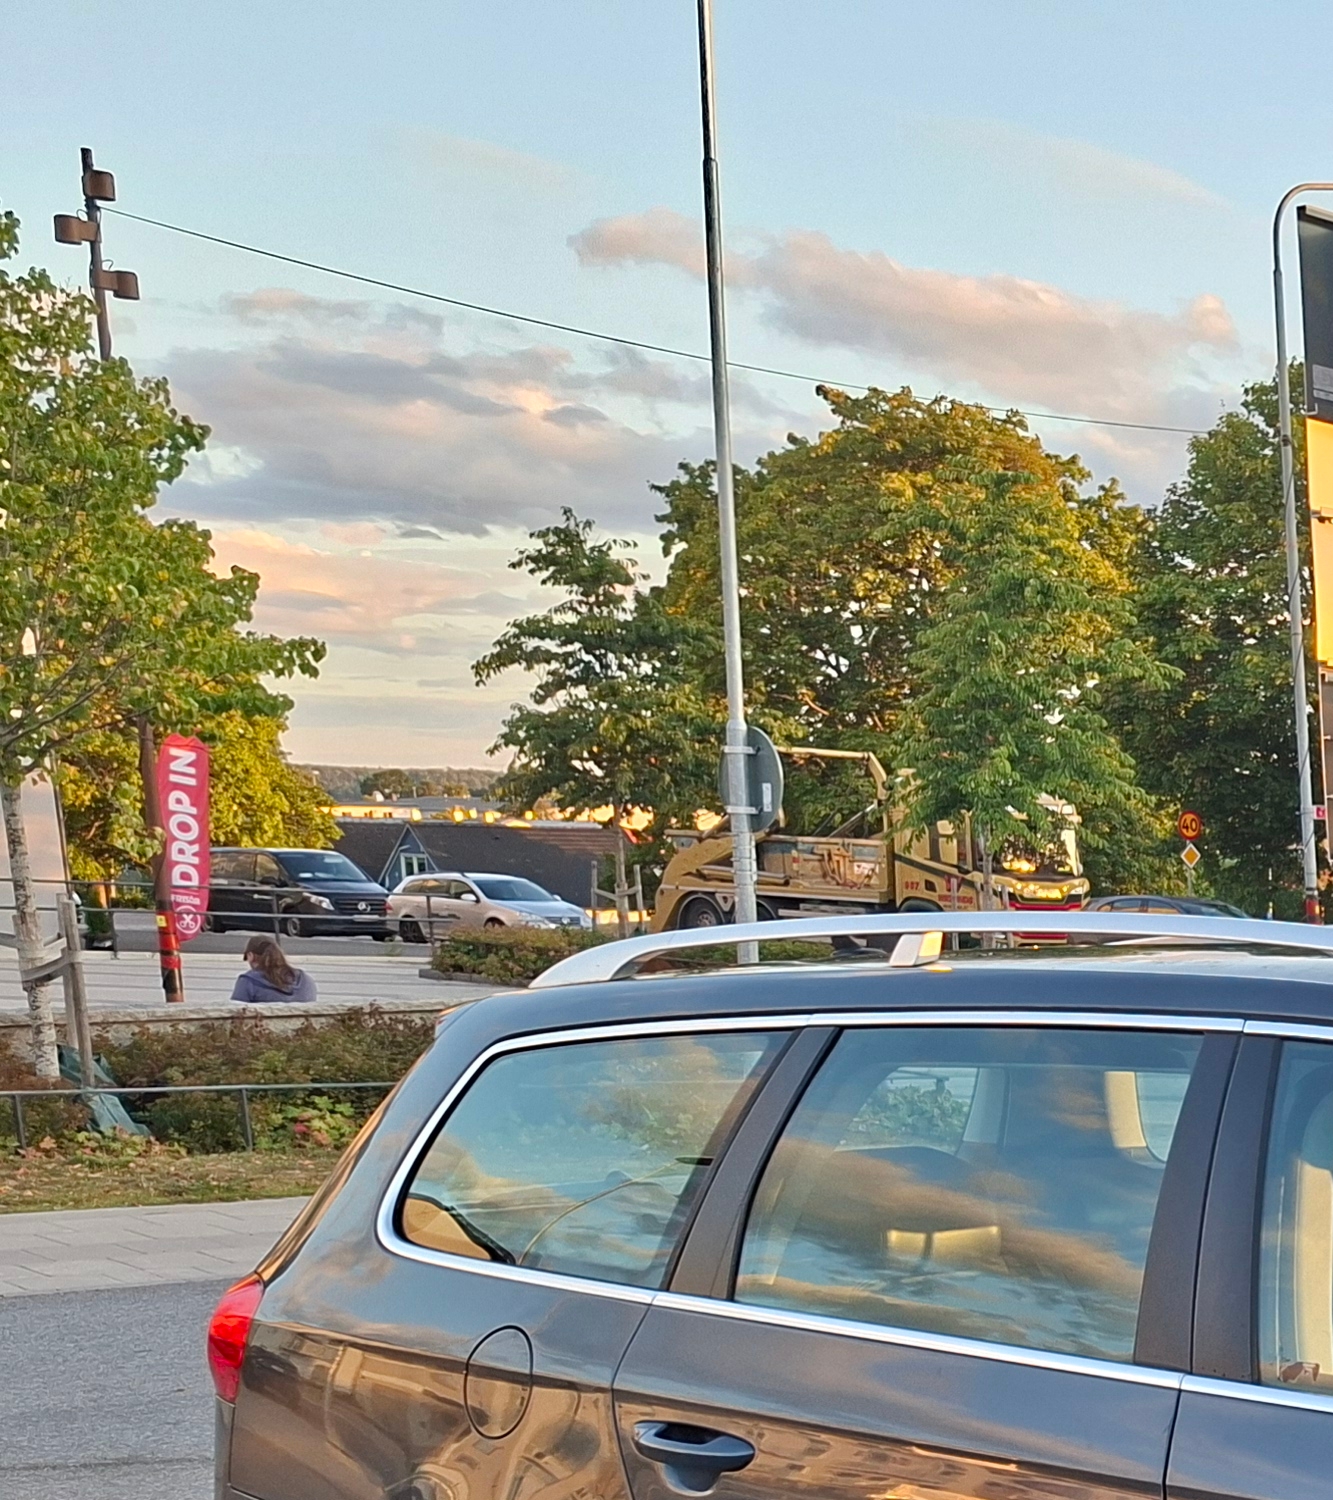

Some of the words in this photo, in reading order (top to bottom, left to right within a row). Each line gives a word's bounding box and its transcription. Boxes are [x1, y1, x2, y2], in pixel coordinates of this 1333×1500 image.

[168, 747, 198, 786] IN
[168, 790, 200, 890] DROP
[1182, 817, 1198, 833] 40
